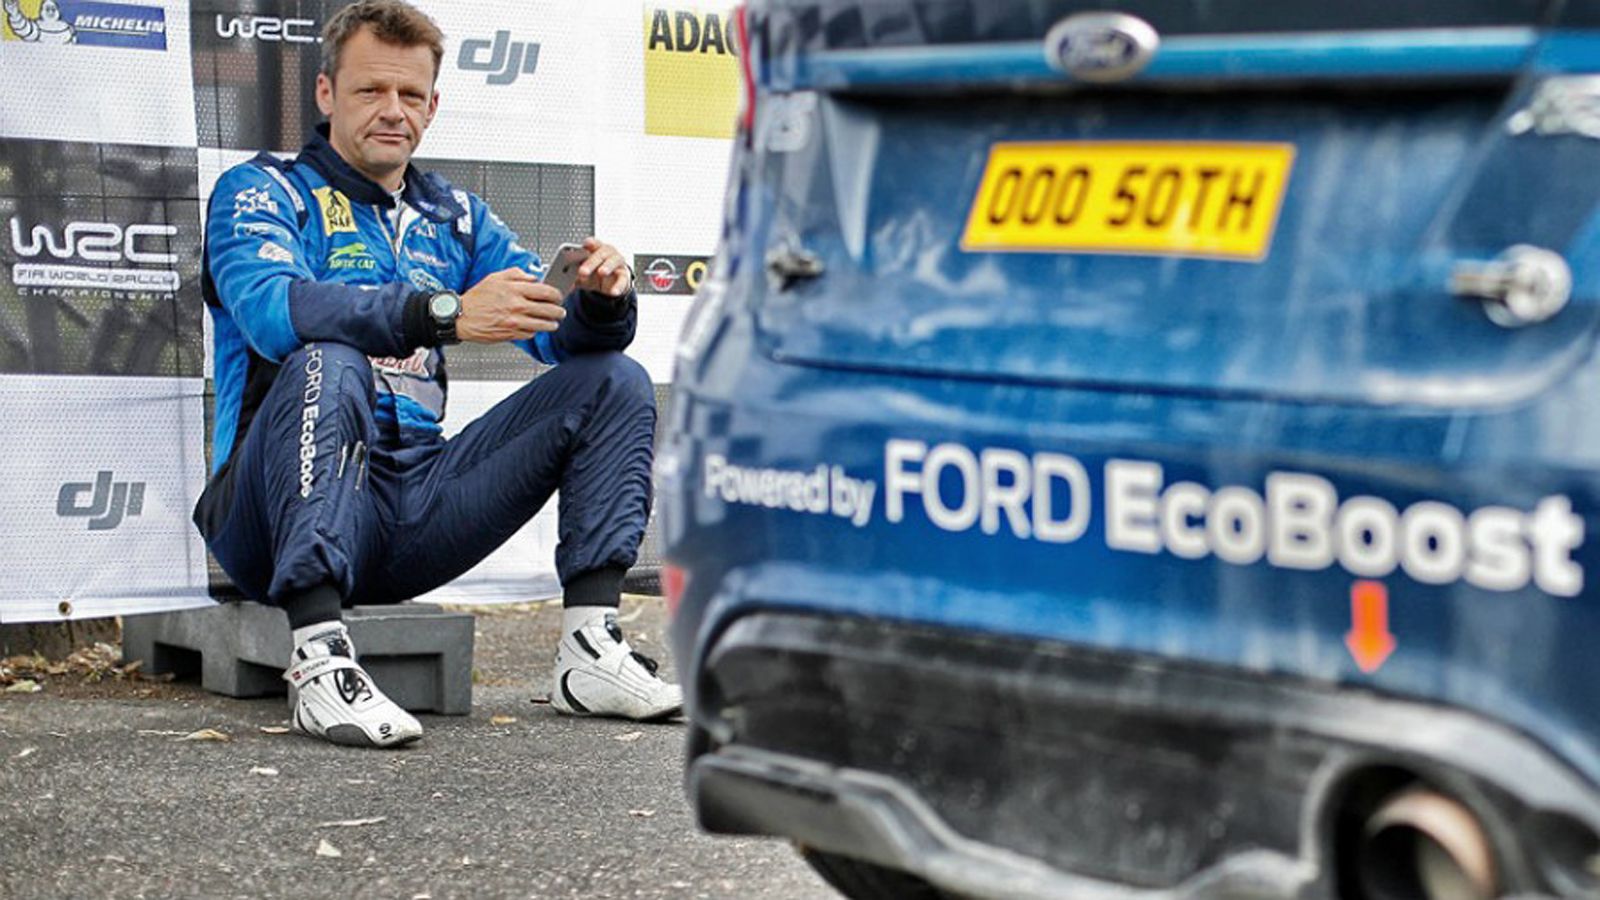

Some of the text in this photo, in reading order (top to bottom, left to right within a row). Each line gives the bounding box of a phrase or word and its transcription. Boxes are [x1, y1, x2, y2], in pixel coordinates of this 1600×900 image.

[75, 14, 165, 33] MICHELIN
[1106, 166, 1265, 231] 50TH
[10, 217, 178, 263] WRC
[17, 268, 175, 286] FIA WORLD RALLY
[304, 348, 322, 403] FORD
[704, 439, 1585, 597] Powered by FORD EcoBoost
